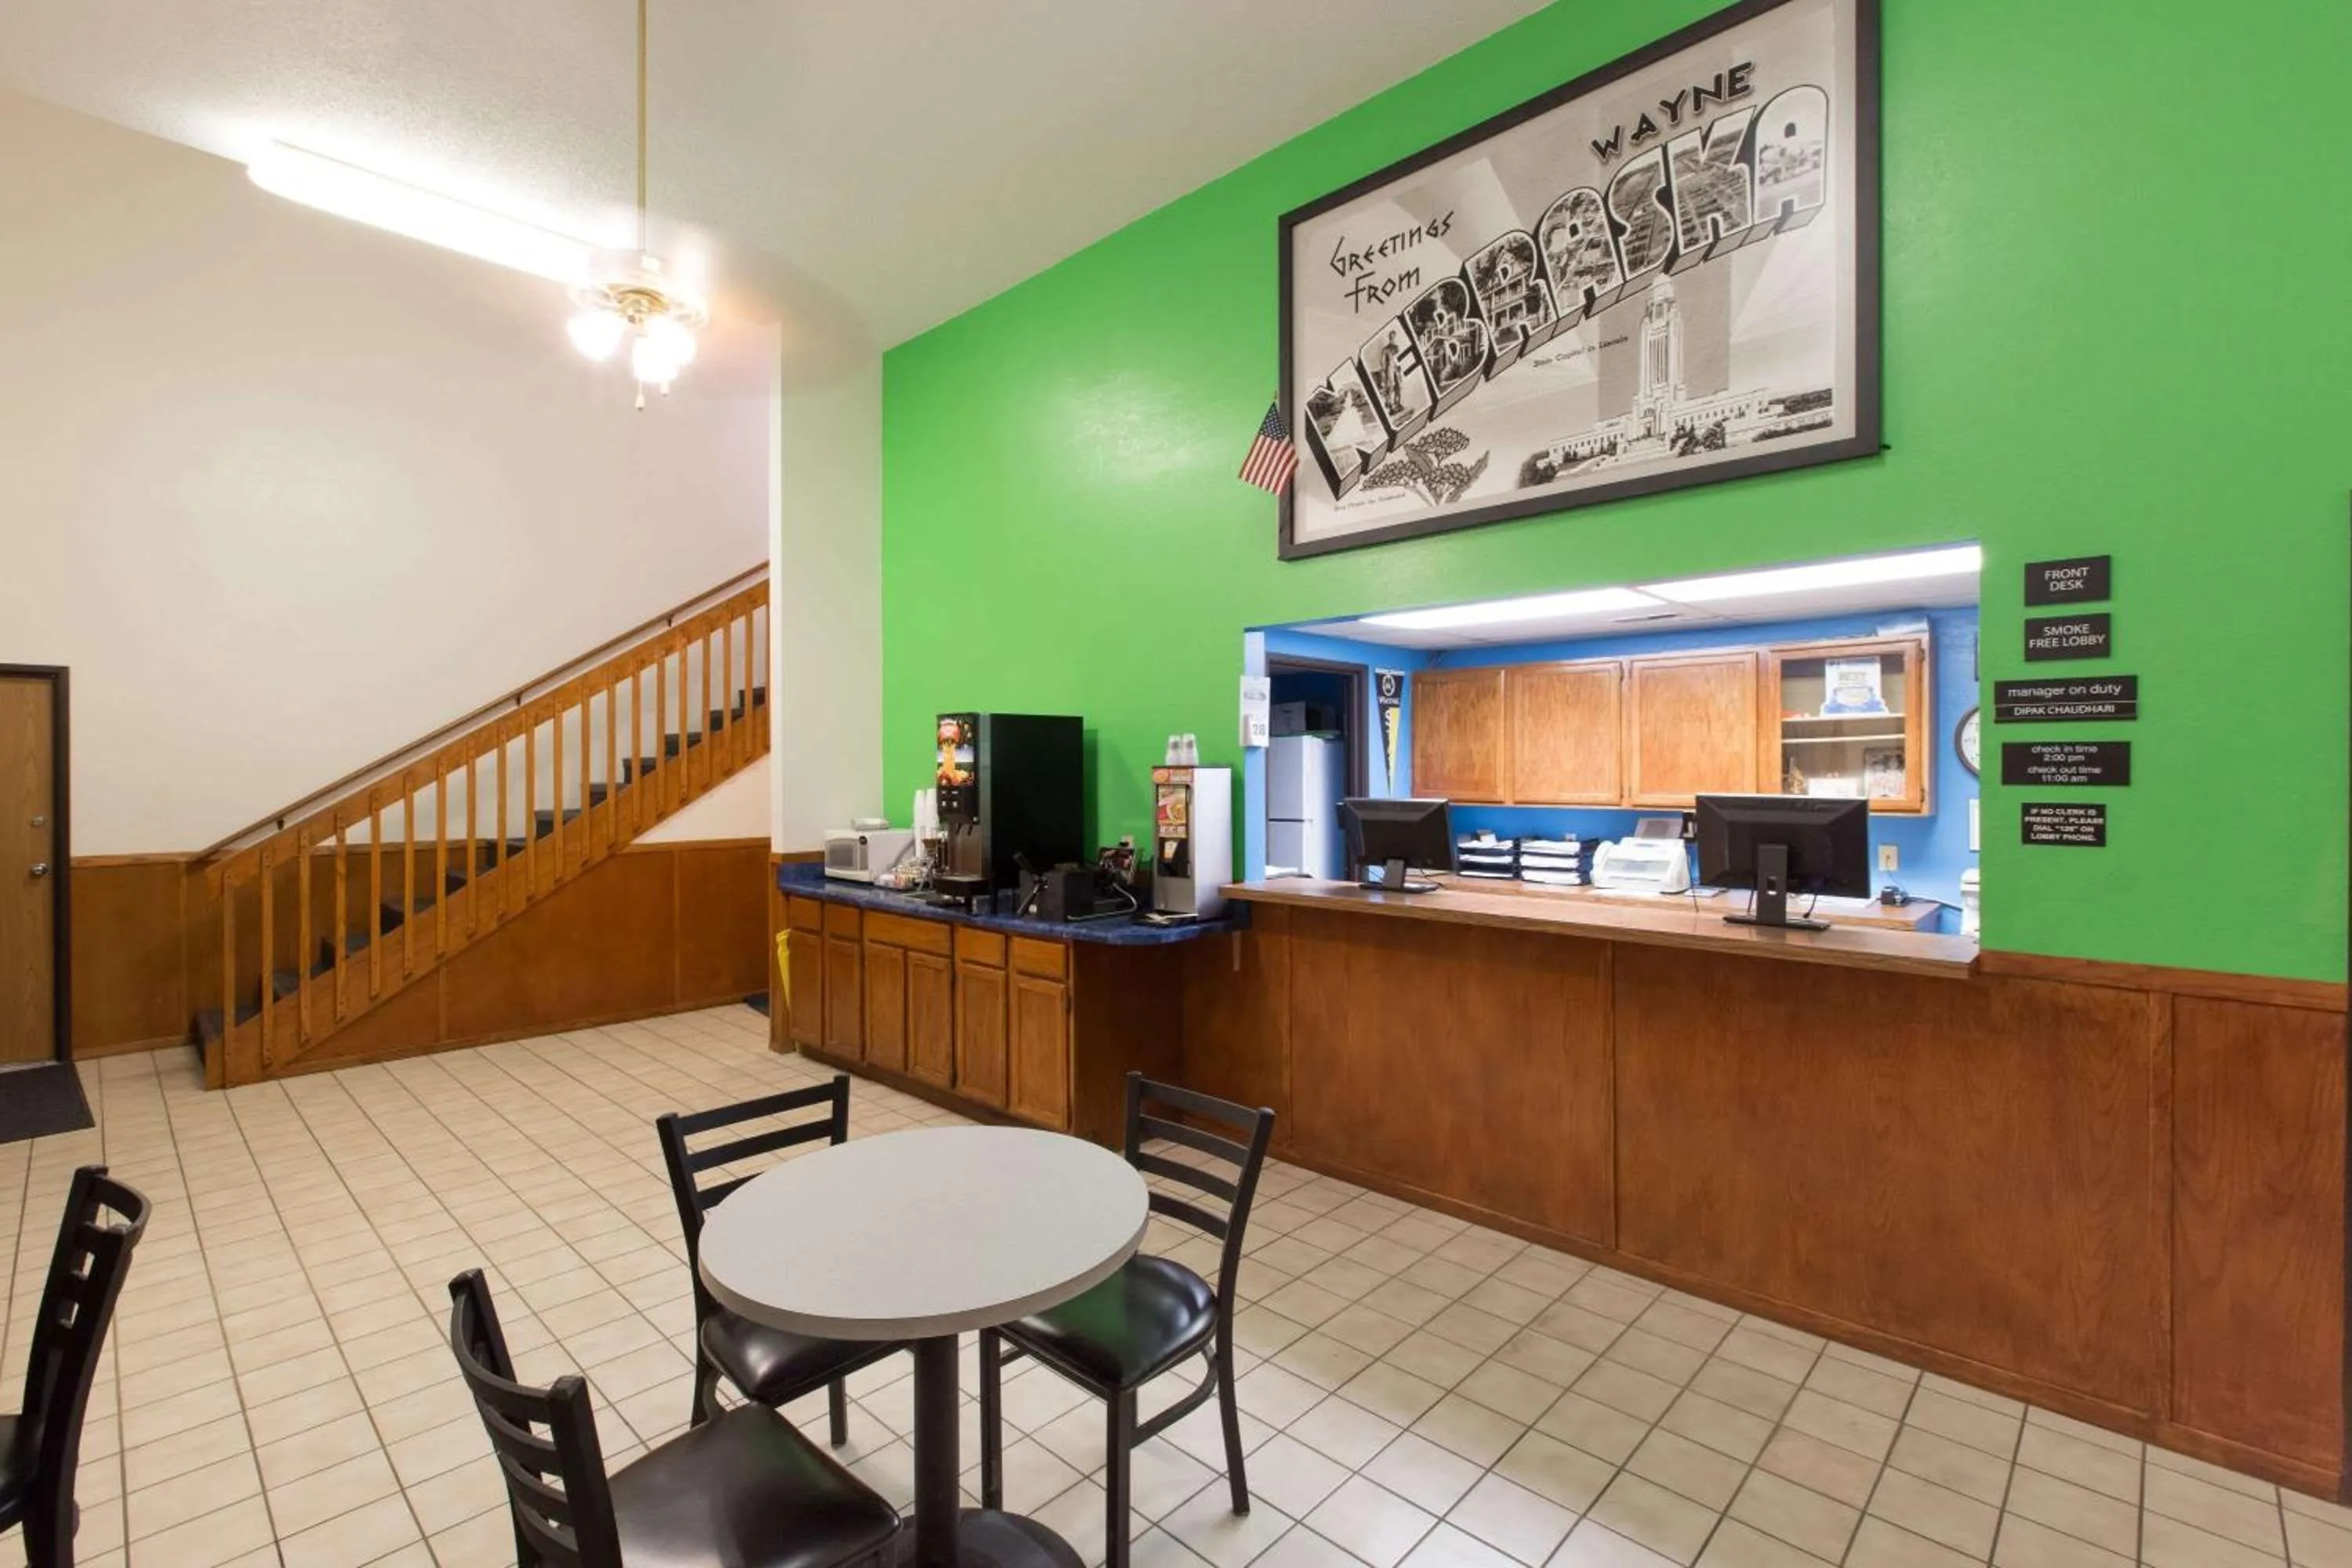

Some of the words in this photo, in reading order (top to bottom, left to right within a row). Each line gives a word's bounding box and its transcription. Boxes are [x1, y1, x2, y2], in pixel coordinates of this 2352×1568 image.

[1591, 61, 1754, 161] WAYNE
[1330, 210, 1454, 278] GREETINGS
[1305, 85, 1829, 501] NEBRASKA
[1344, 267, 1420, 314] FROM
[2044, 566, 2090, 581] FRONT
[2049, 579, 2085, 592] DESK
[2043, 623, 2090, 637] SMOKE
[2028, 637, 2060, 649] FREE
[2063, 634, 2106, 647] LOBBY
[2008, 687, 2066, 699] manager
[2068, 686, 2086, 695] on
[2089, 684, 2122, 695] duty
[2013, 706, 2045, 716] DIPAK
[2031, 745, 2061, 753] check
[2063, 745, 2074, 753] in
[2075, 745, 2099, 753] time
[2078, 765, 2102, 774] time
